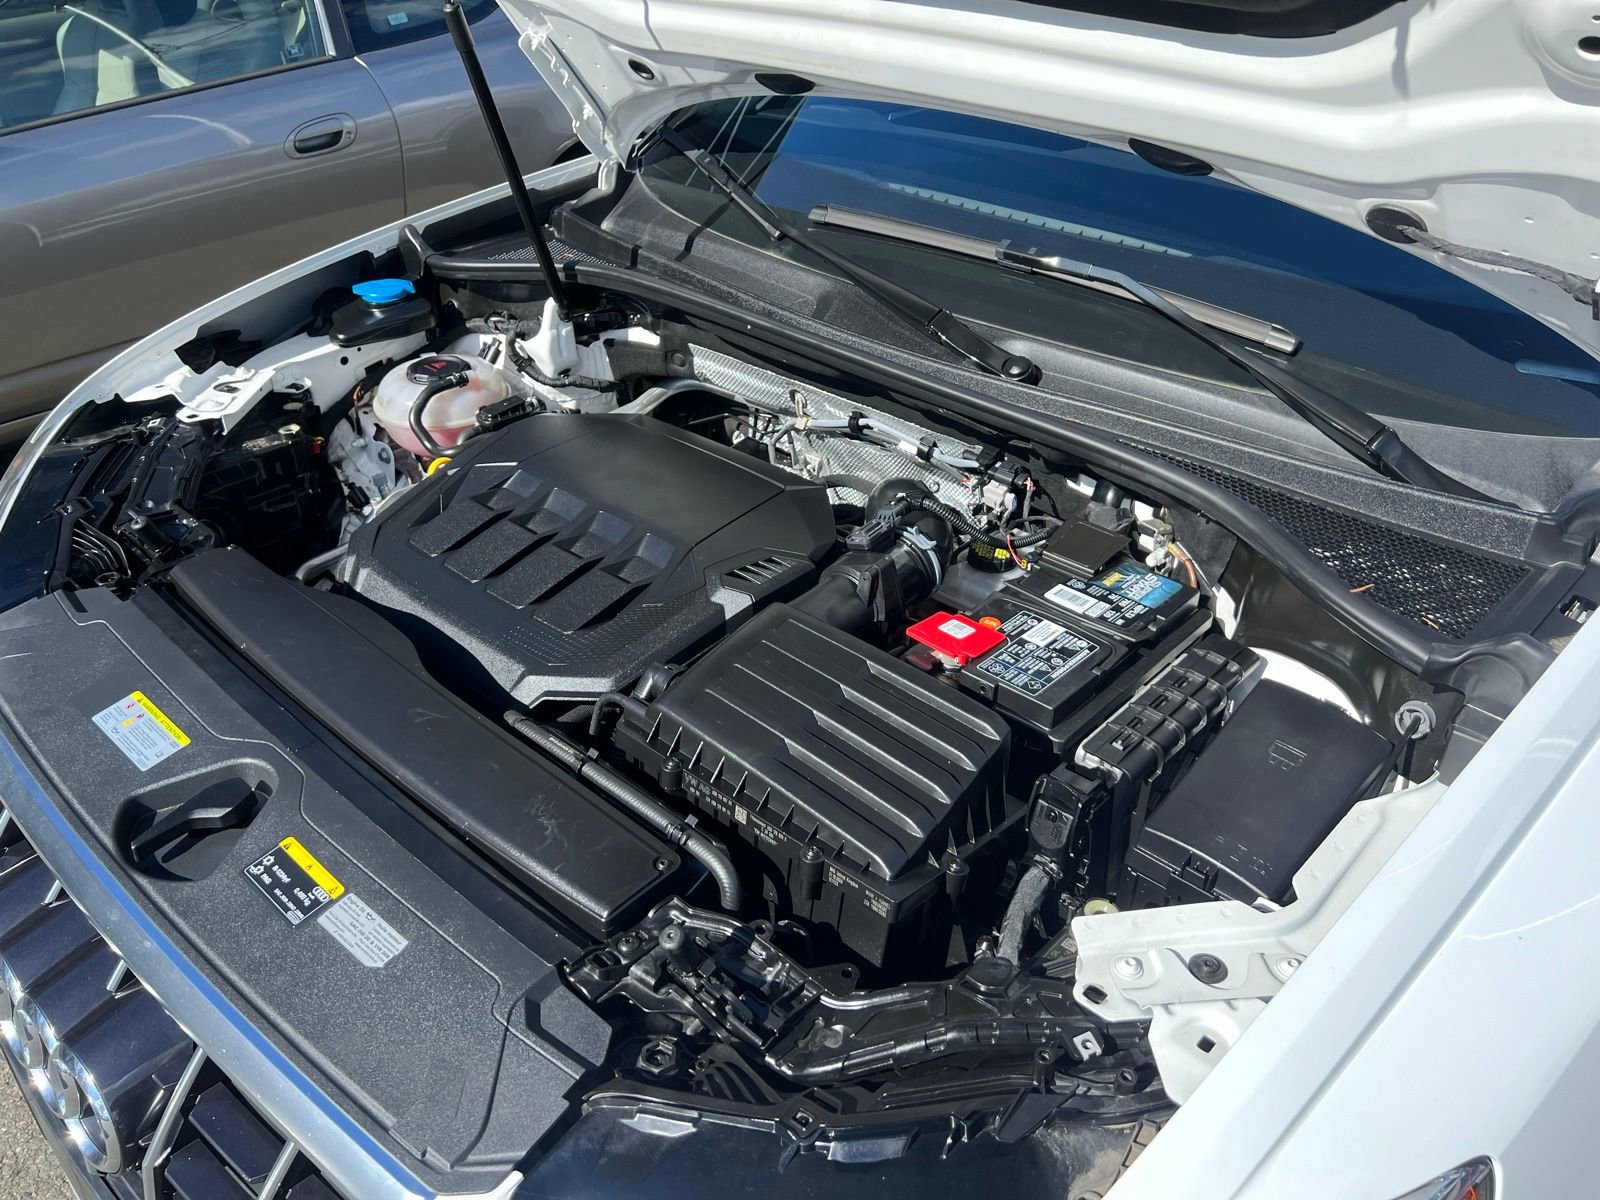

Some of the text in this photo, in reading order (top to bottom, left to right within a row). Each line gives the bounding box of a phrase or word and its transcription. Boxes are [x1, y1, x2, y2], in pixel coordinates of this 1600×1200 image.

[1124, 573, 1158, 598] START
[1130, 580, 1162, 602] SUPER
[142, 701, 162, 721] WARNING
[159, 719, 182, 741] ATTENTION
[260, 873, 273, 885] PAG
